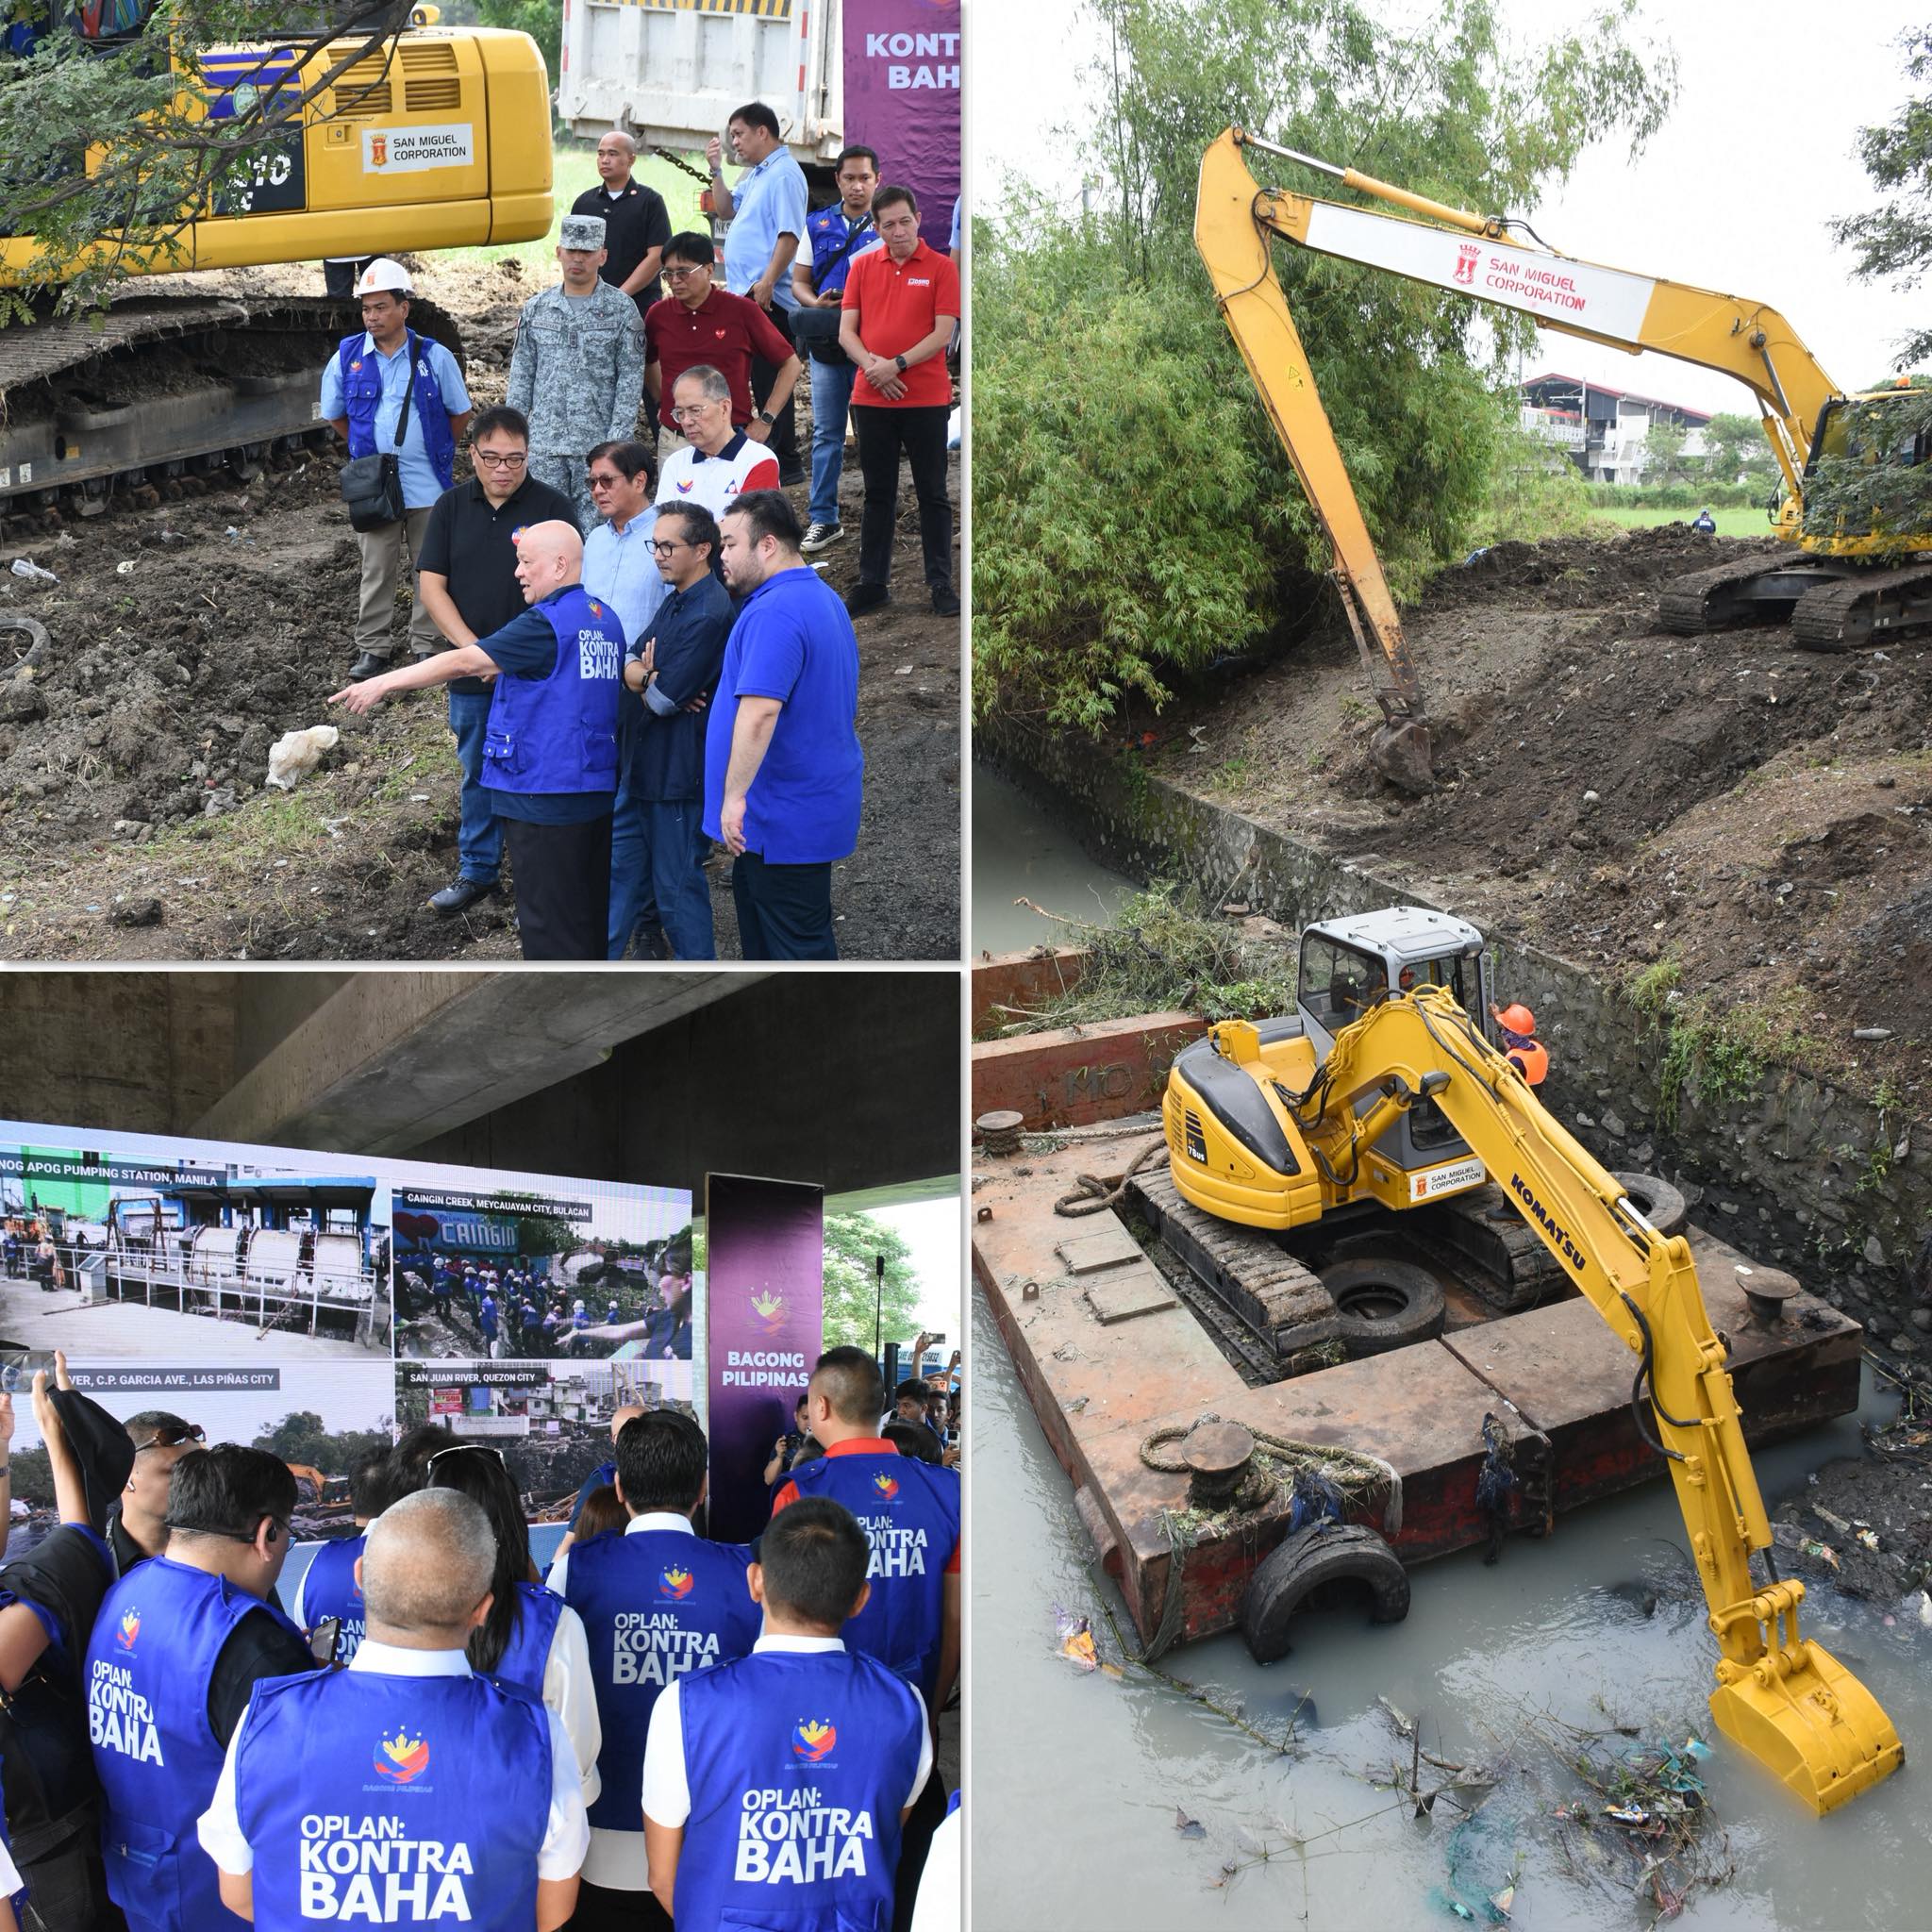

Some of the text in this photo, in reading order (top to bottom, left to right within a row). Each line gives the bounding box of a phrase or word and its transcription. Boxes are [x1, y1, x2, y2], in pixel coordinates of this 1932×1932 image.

[866, 33, 960, 58] KONT
[889, 65, 960, 90] BAH
[393, 135, 457, 148] SAN MIGUEL
[393, 146, 467, 160] CORPORATION
[1490, 258, 1576, 292] SAN MIGUEL
[1486, 275, 1586, 311] CORPORATION
[579, 641, 619, 658] KONTRA
[580, 656, 619, 679] BAHA
[27, 1161, 61, 1174] APOG
[63, 1164, 119, 1178] PUMPING
[121, 1169, 173, 1185] STATION,
[175, 1174, 218, 1186] MANILA
[1431, 1166, 1474, 1183] SAN MIGUEL
[1431, 1172, 1481, 1191] CORPORATION
[408, 1193, 590, 1217] CAINGIN CREEK, MEYCAUAYAN CITY, BULACAN
[1510, 1173, 1587, 1271] KOMATSU
[727, 1351, 805, 1368] BAGONG
[67, 1375, 94, 1388] VER,
[96, 1375, 117, 1385] C.P.
[119, 1375, 162, 1385] GARCIA
[193, 1374, 215, 1385] LAS
[216, 1373, 249, 1385] PIÑAS
[250, 1374, 275, 1385] CITY
[410, 1373, 536, 1384] SAN JUAN RIVER, QUEZON CITY
[722, 1371, 809, 1387] PILIPINAS
[857, 1515, 893, 1530] PLAN:
[864, 1528, 928, 1550] ONTRA
[865, 1547, 926, 1579] AHA
[614, 1612, 678, 1630] OPLAN:
[613, 1629, 720, 1655] KONTRA
[89, 1703, 164, 1766] BAHA
[741, 1787, 822, 1810] OPLAN:
[300, 1814, 406, 1840] OPLAN:
[739, 1807, 874, 1840] KONTRA
[300, 1839, 474, 1874] KONTRA
[734, 1835, 867, 1884] BAHA
[300, 1870, 473, 1923] BAHA
